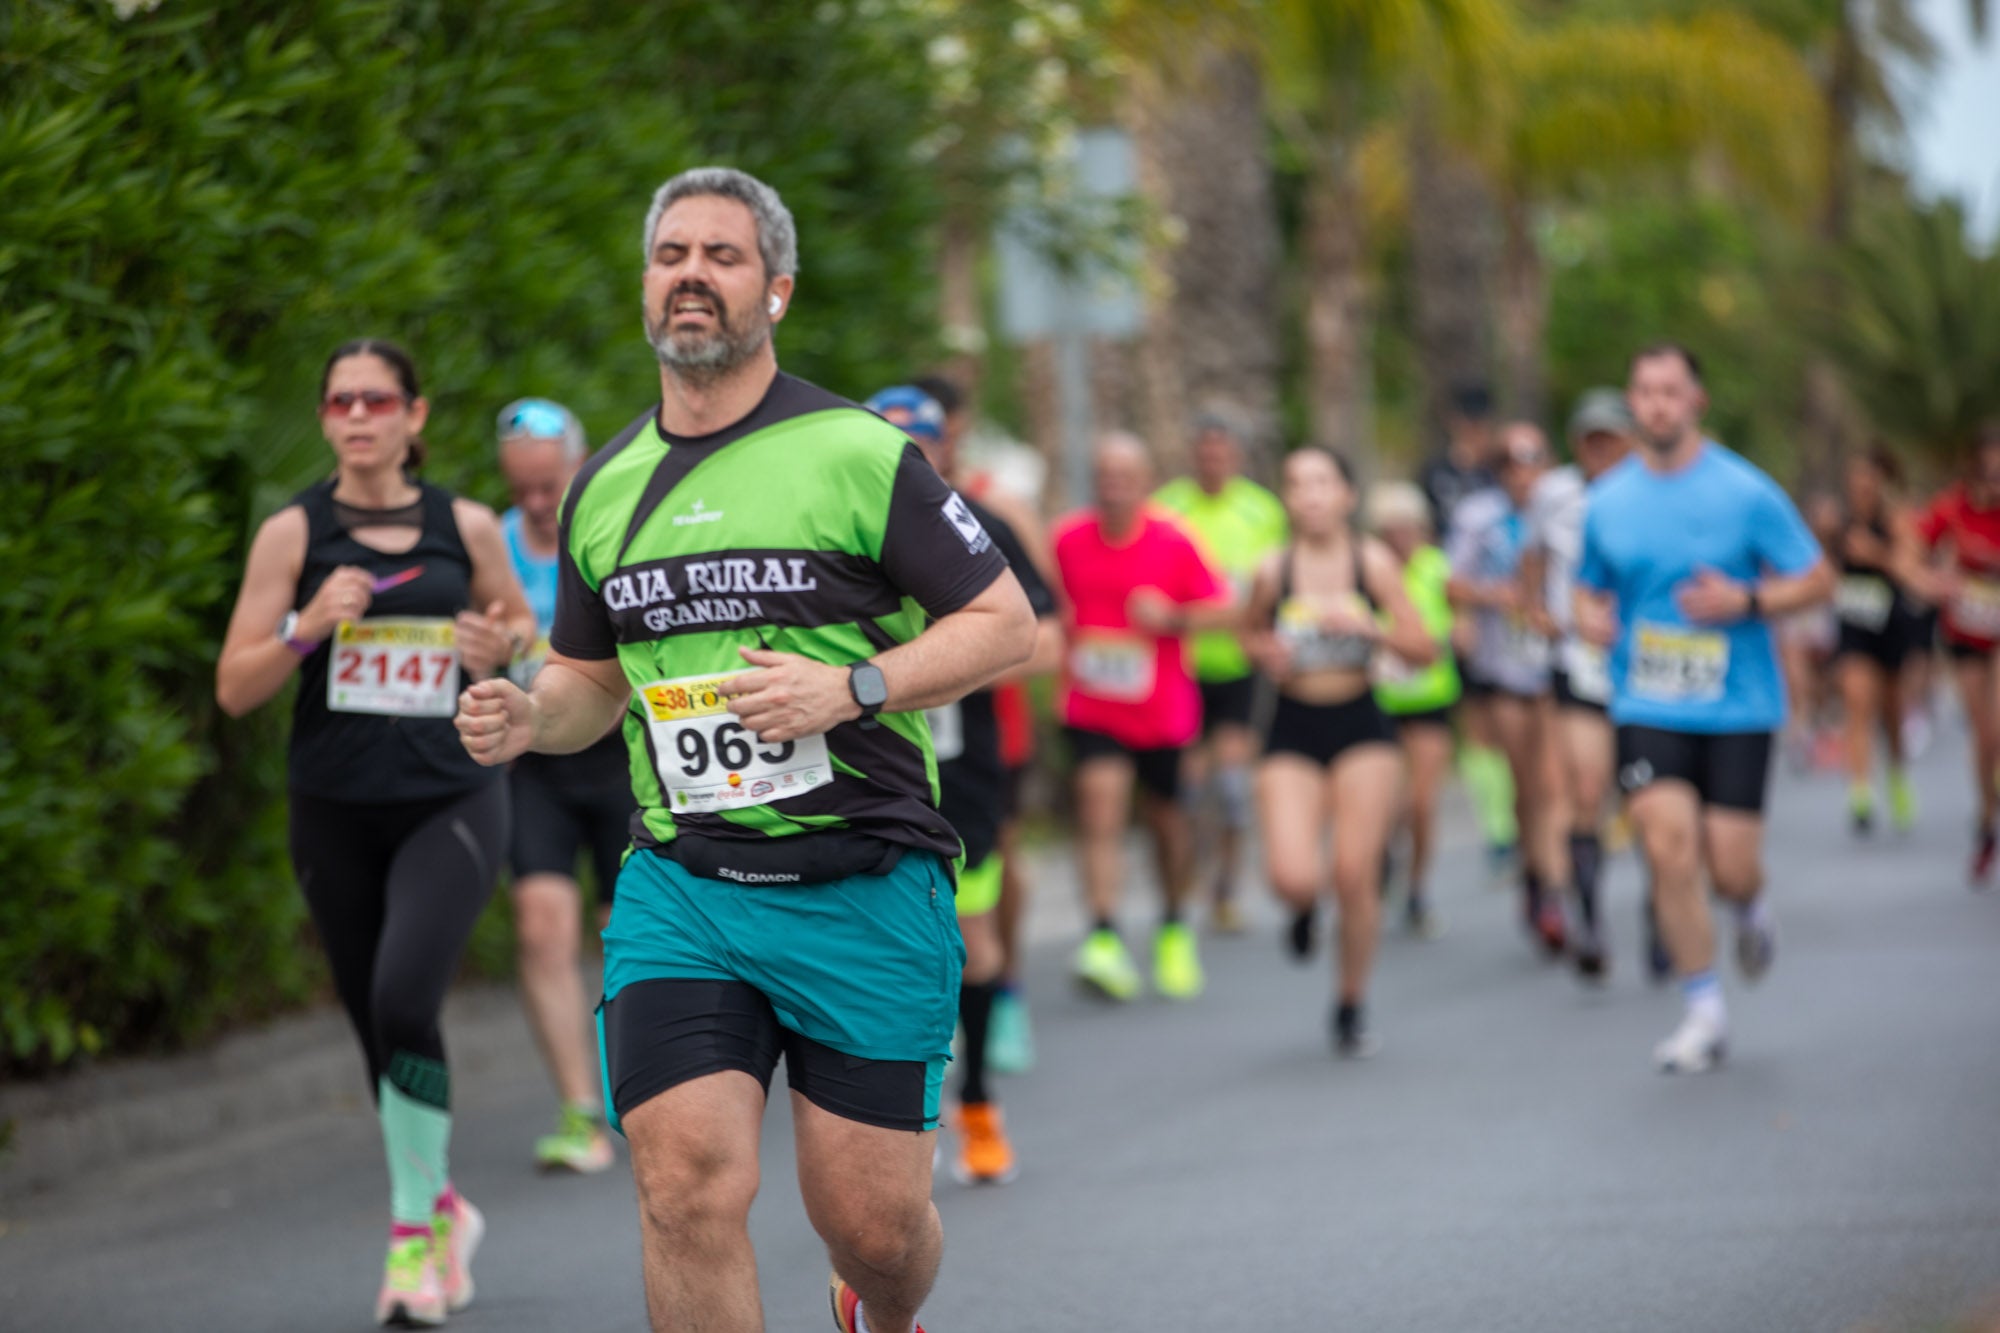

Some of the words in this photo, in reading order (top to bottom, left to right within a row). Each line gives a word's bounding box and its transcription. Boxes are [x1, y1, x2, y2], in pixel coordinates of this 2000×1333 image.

[603, 568, 676, 611] CAJA
[685, 558, 817, 595] RURAL
[643, 599, 763, 632] GRANADA
[336, 650, 453, 691] 2147
[666, 687, 688, 710] 38
[676, 722, 796, 777] 965
[717, 866, 800, 883] SALOMON
